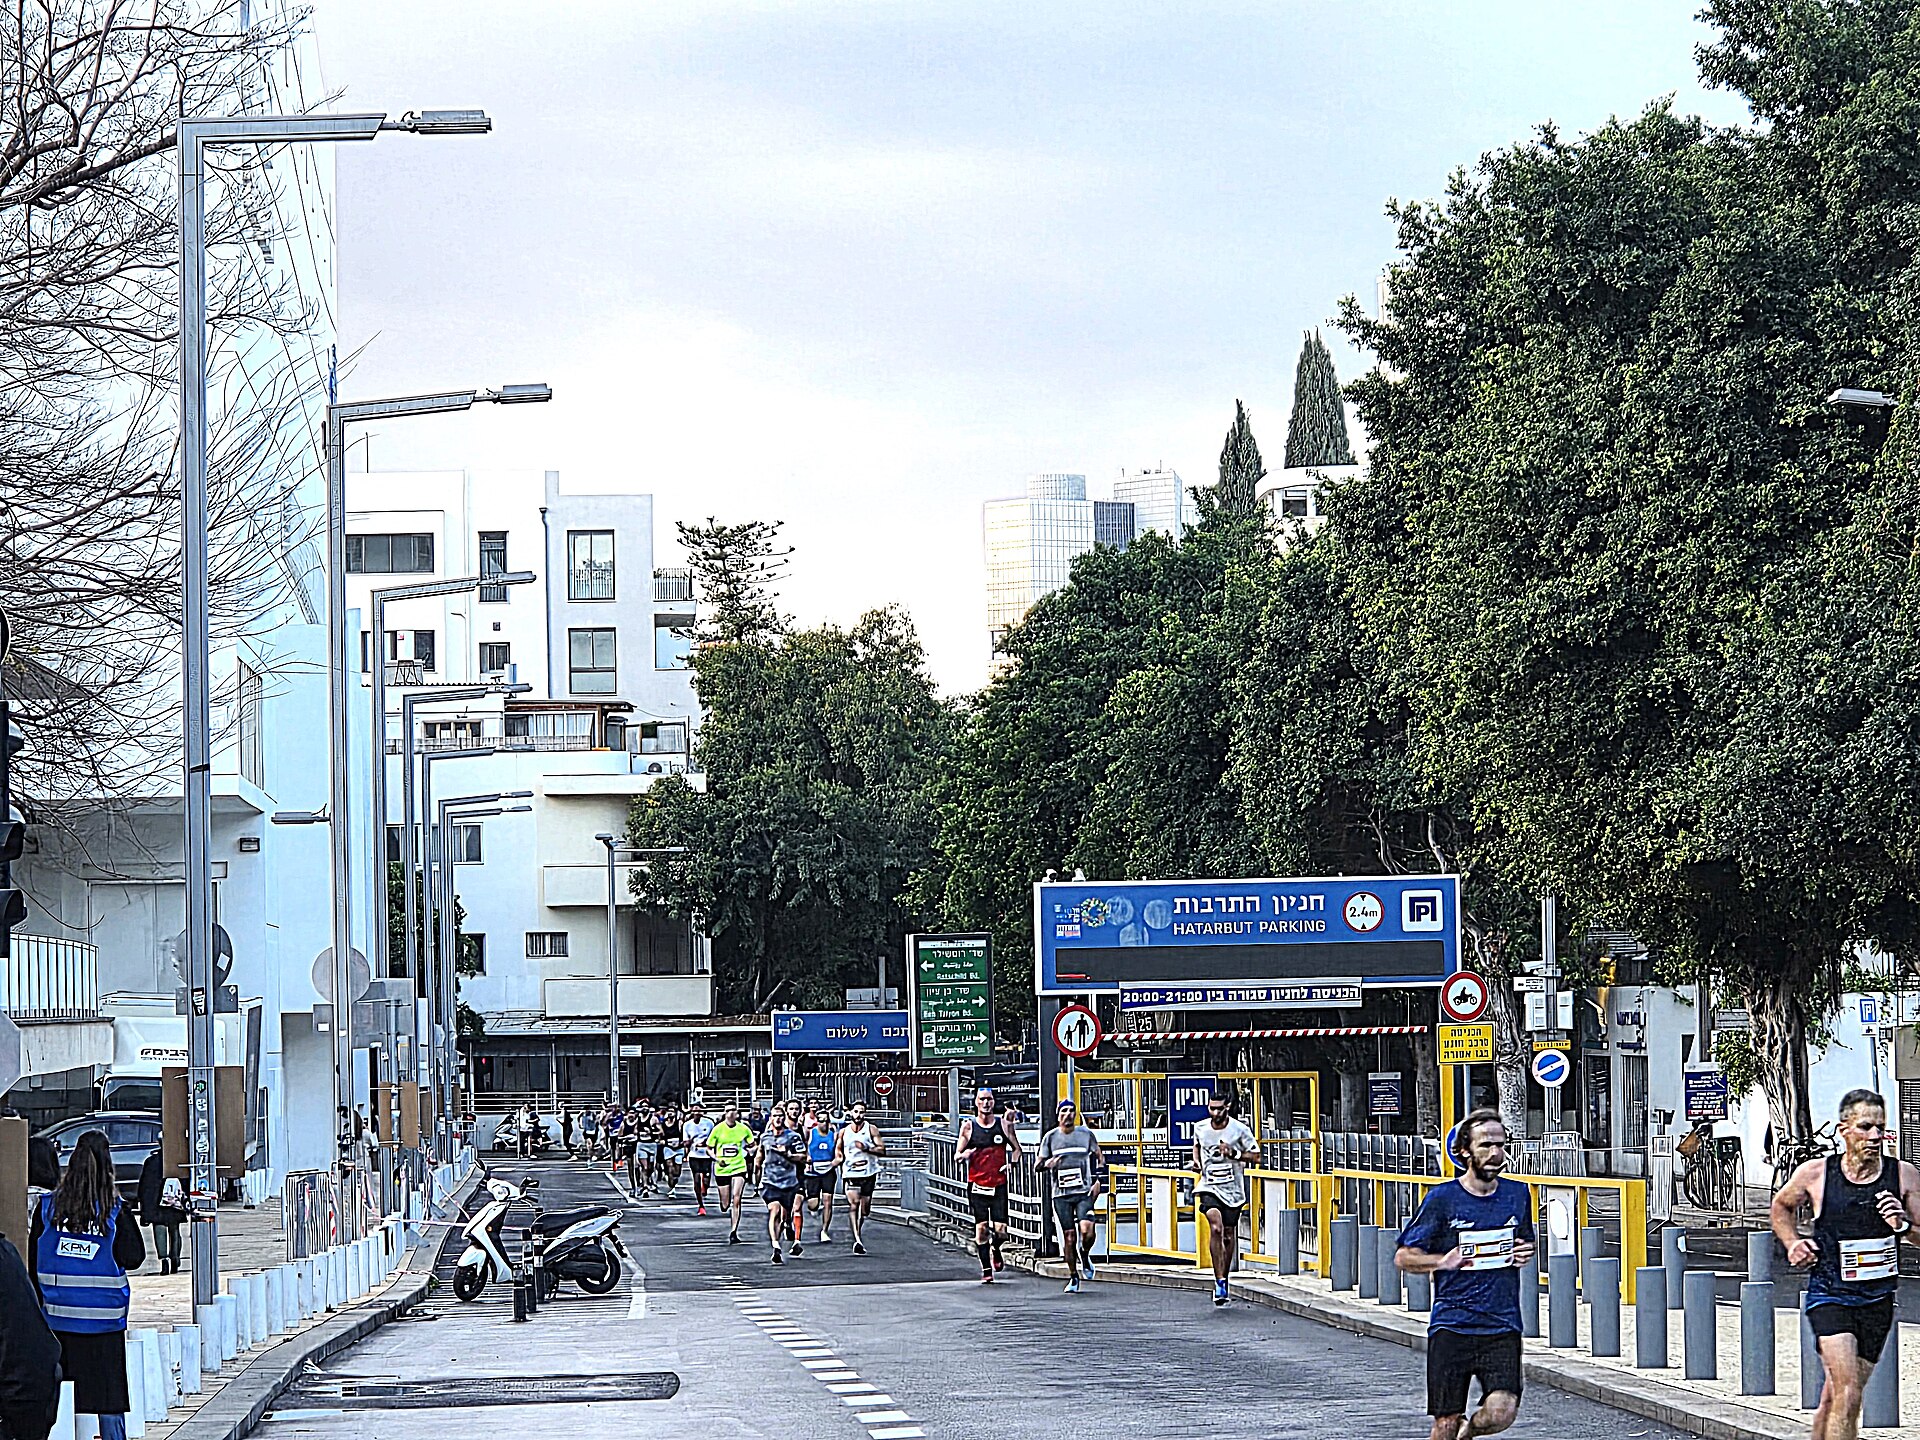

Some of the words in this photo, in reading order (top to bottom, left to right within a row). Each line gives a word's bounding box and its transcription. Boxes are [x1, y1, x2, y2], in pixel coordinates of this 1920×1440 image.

[1173, 895, 1261, 914] התרבות
[1272, 895, 1325, 915] חניון
[1173, 921, 1254, 936] HATARBUT
[1259, 919, 1326, 934] PARKING
[1122, 990, 1203, 1003] 20:00-21:00
[1206, 990, 1225, 1003] בין
[1228, 989, 1267, 1001] סגורה
[1270, 986, 1308, 1002] לחניון
[1311, 987, 1359, 999] הכניסה
[826, 1025, 869, 1039] לשלום
[1175, 1087, 1210, 1111] חניון
[60, 1241, 92, 1254] KPM
